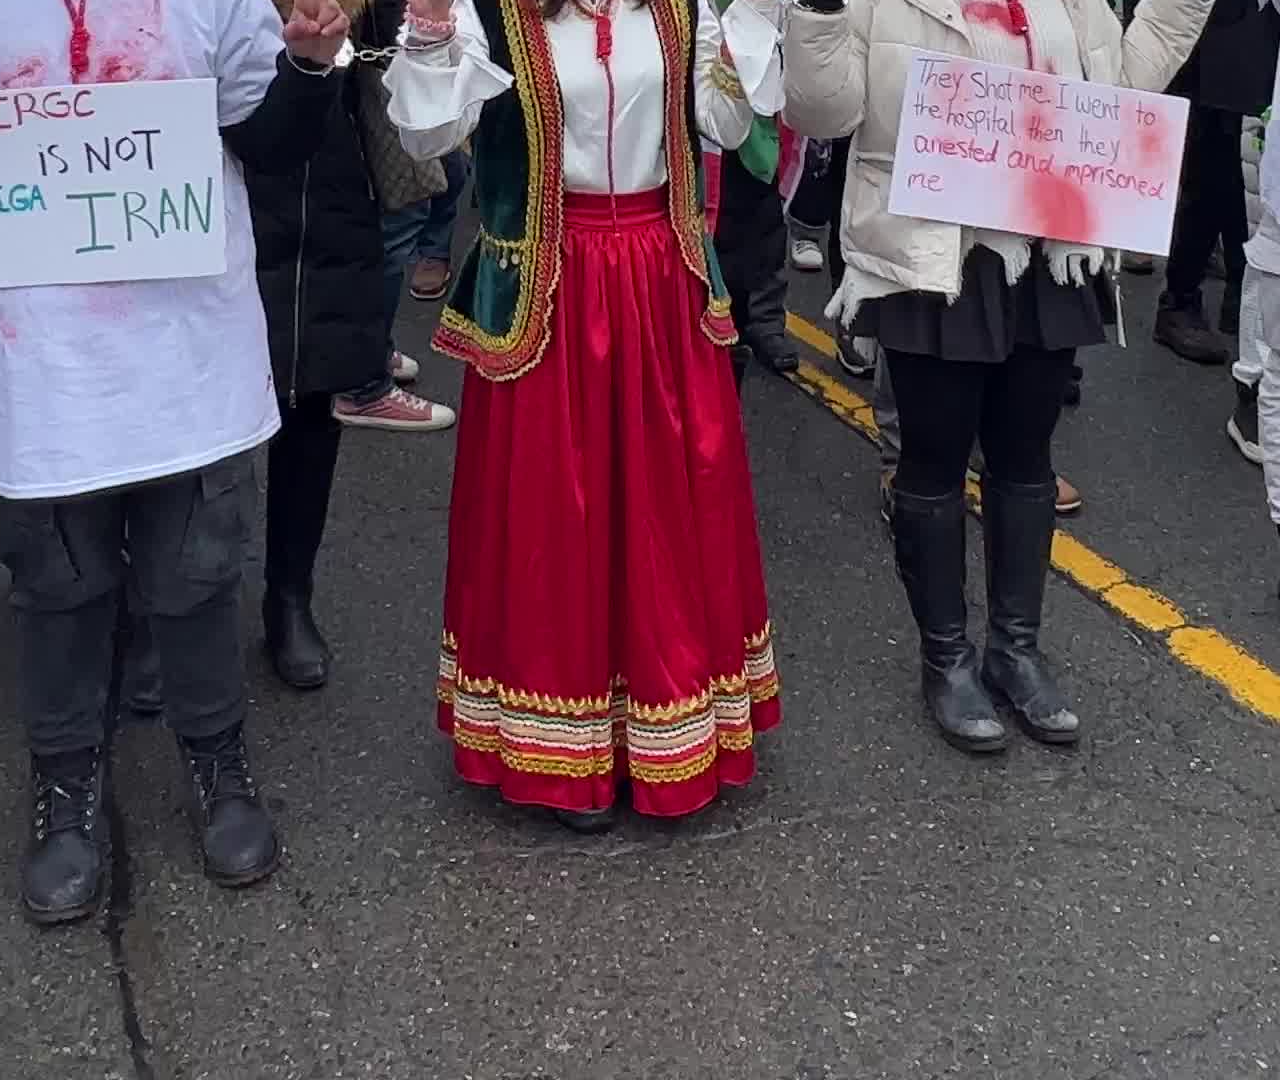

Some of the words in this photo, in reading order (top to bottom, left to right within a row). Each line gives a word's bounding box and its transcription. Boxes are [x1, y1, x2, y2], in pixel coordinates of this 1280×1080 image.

[917, 58, 964, 102] They
[1056, 82, 1070, 110] I
[1074, 92, 1122, 121] went
[1135, 99, 1157, 127] to
[84, 129, 162, 174] NOT
[913, 91, 943, 120] the
[1026, 114, 1064, 143] then
[1079, 120, 1122, 166] they
[913, 134, 1000, 164] arrested
[1007, 150, 1056, 176] and
[907, 171, 946, 193] me
[66, 176, 213, 255] IRAN
